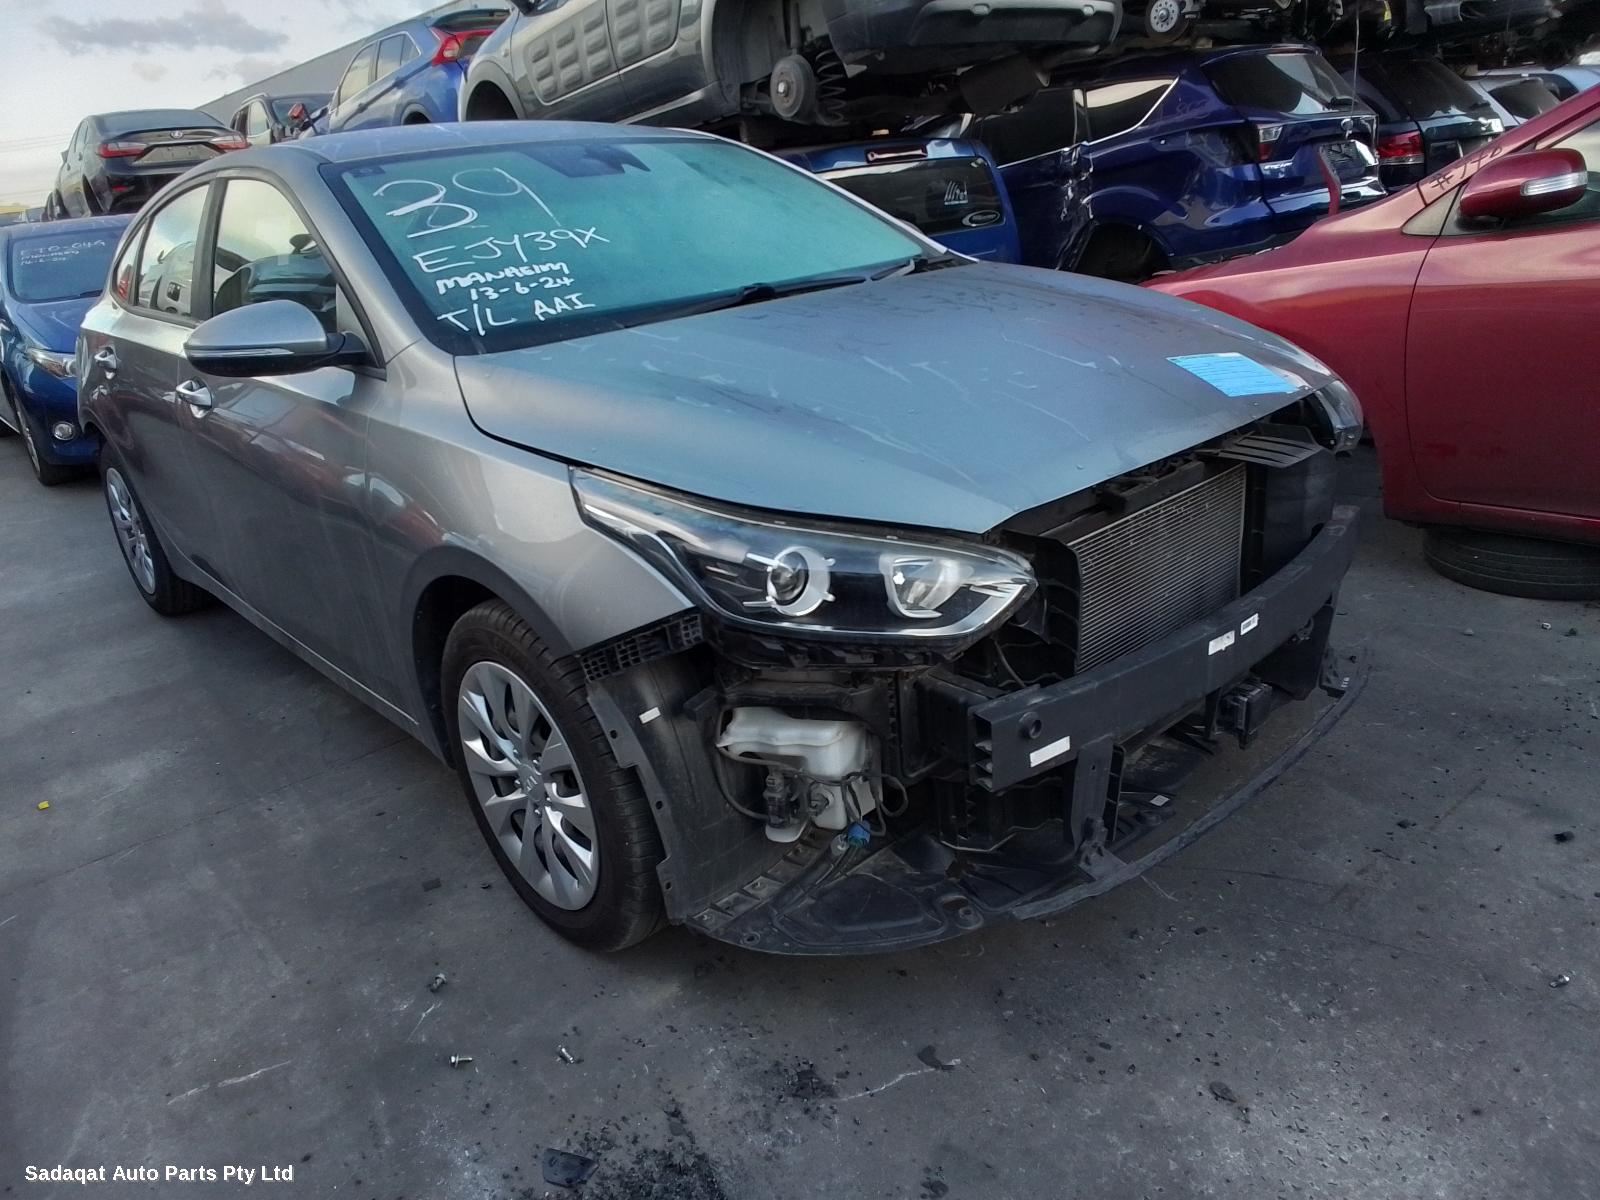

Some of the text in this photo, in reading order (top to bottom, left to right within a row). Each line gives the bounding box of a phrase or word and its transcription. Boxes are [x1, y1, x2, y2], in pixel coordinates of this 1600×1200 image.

[436, 261, 570, 295] MANHEIM
[470, 276, 575, 301] 13-6-24
[437, 292, 596, 336] T/L AAI
